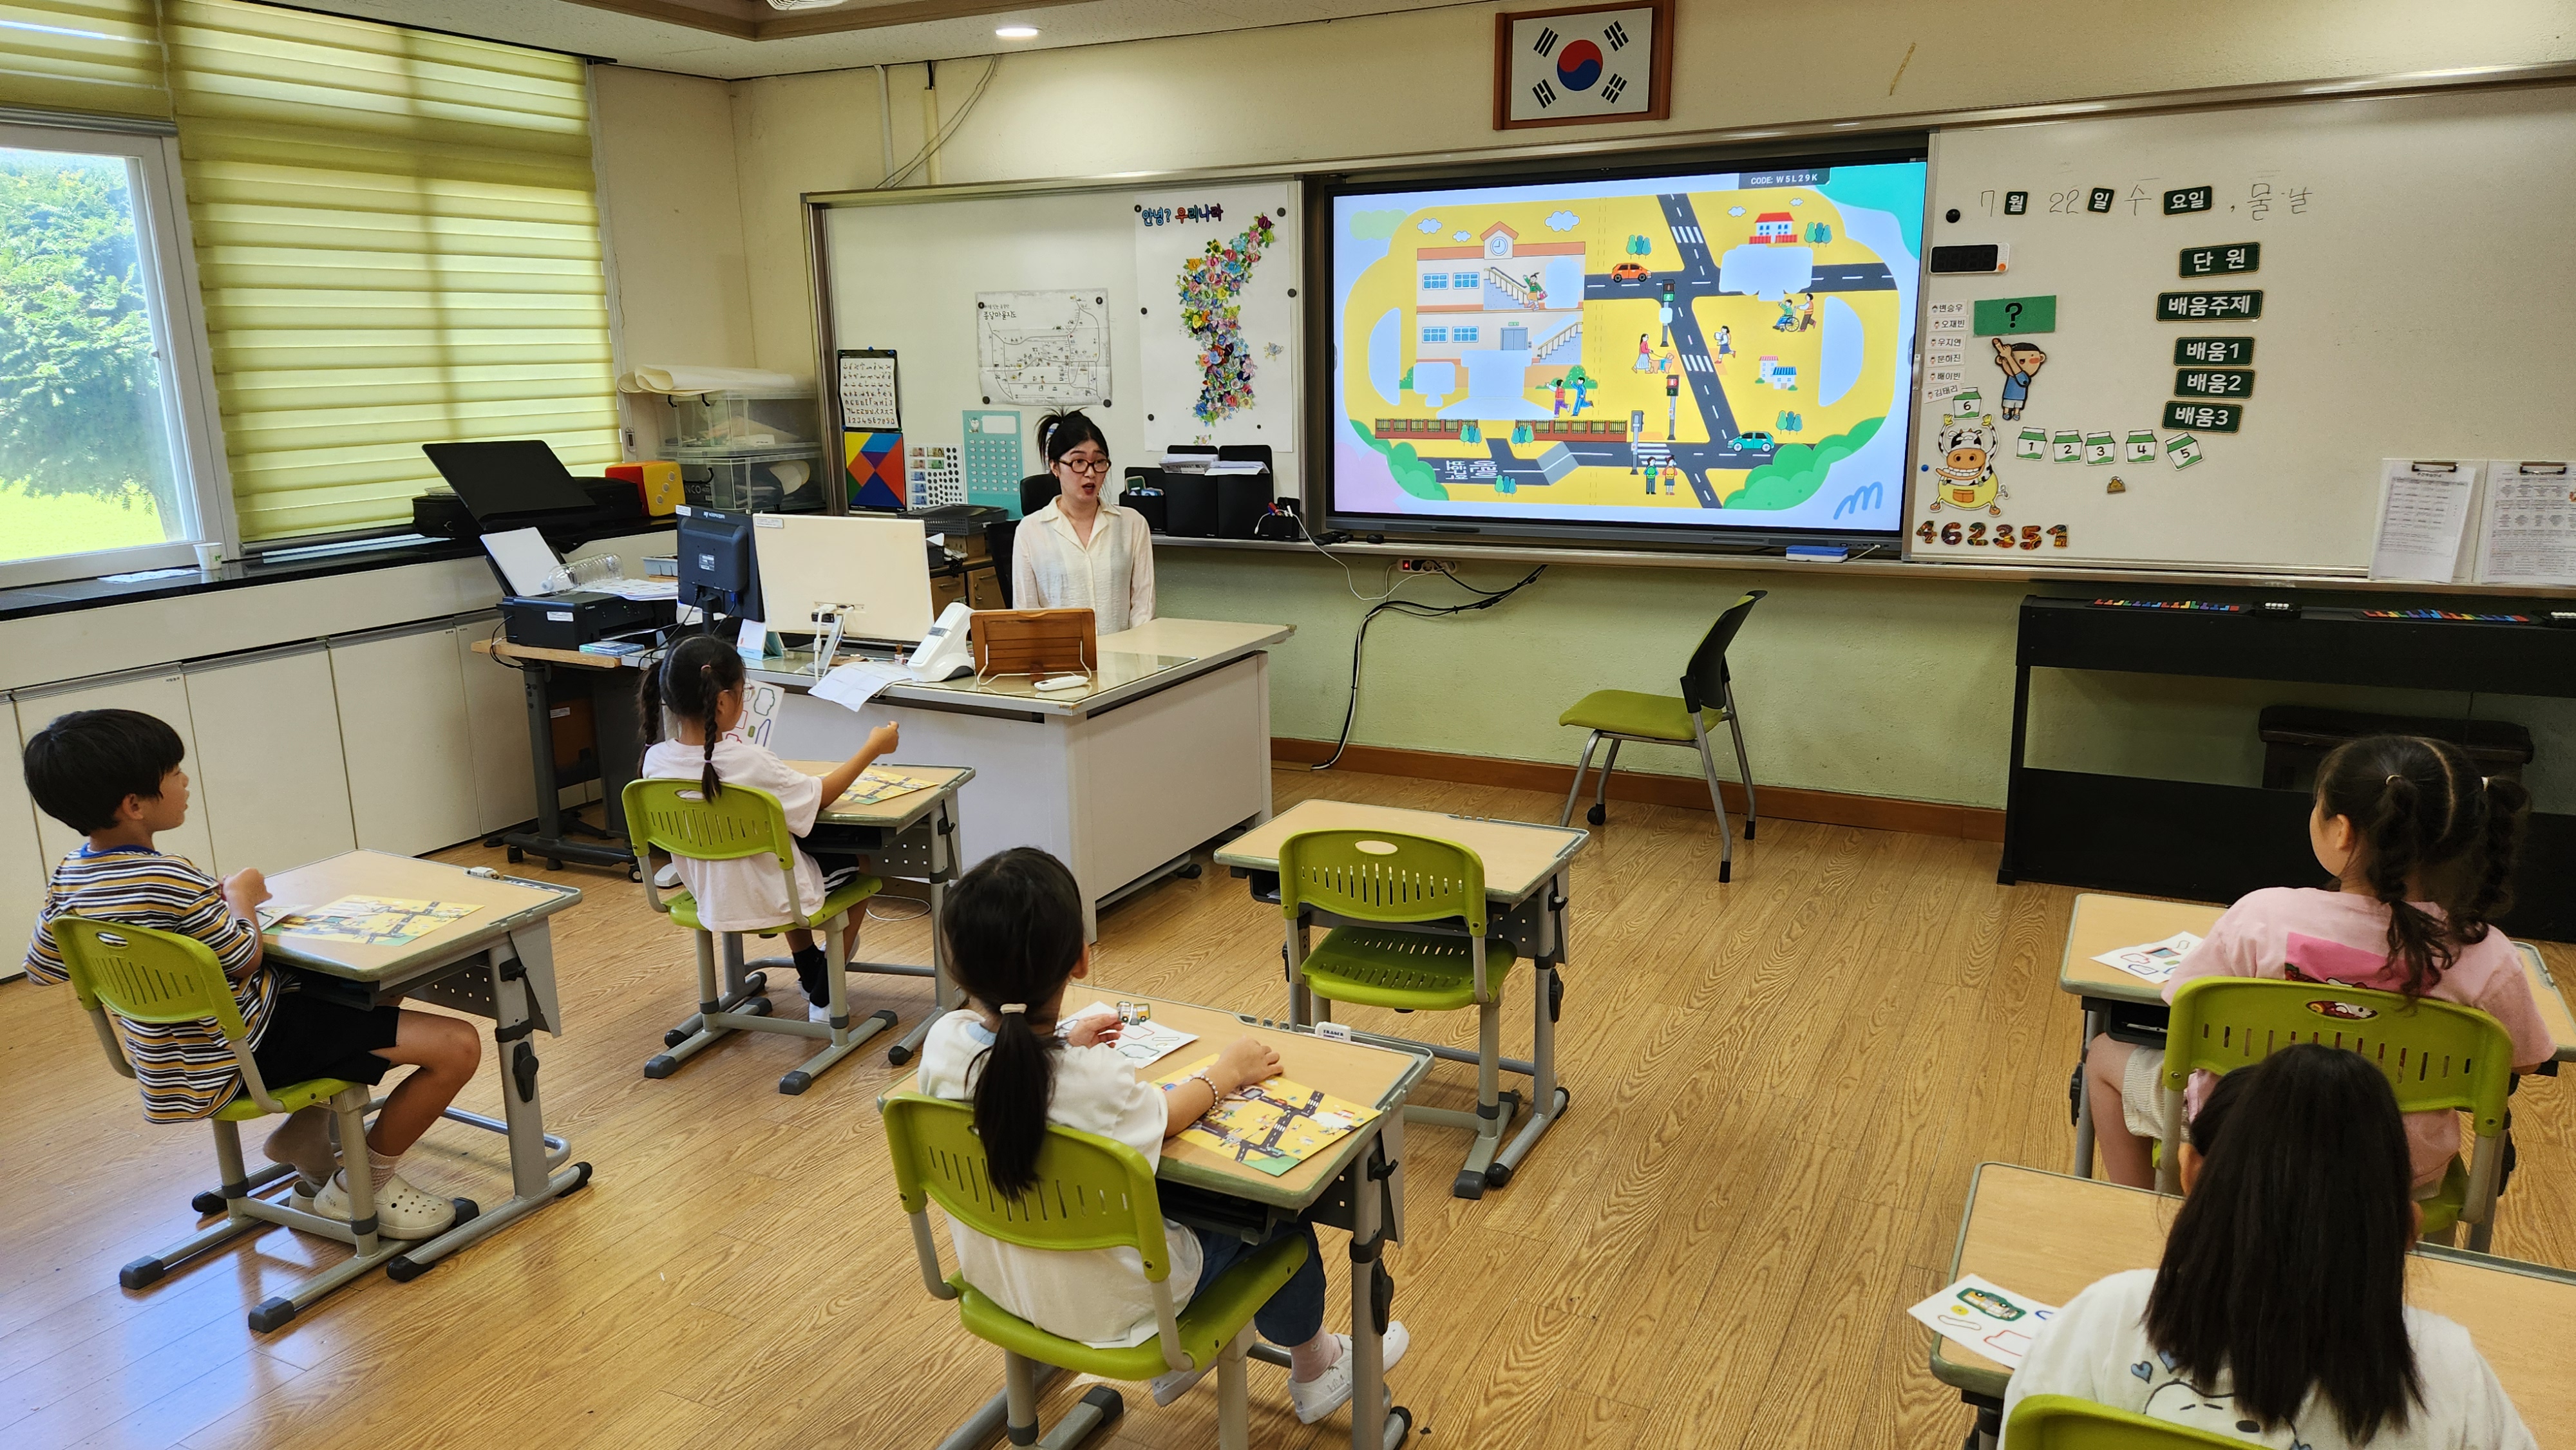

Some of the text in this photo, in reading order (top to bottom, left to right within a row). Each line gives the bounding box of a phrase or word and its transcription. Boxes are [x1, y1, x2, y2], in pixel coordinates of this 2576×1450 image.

[1750, 176, 1773, 185] CODE:
[1981, 190, 1995, 217] 7
[2009, 194, 2024, 212] 월
[2049, 189, 2079, 214] 22
[2094, 192, 2110, 210] 일
[2124, 184, 2152, 216] 수
[2170, 190, 2204, 209] 요일
[1142, 202, 1224, 227] 안녕? 우리나라
[1939, 303, 1963, 313] 변승우
[2168, 294, 2251, 316] 배움주제
[1941, 319, 1965, 328] 오재빈
[1938, 338, 1962, 347] 우지연
[2186, 341, 2239, 362] 배움1
[1937, 353, 1961, 364] 문하진
[1937, 372, 1961, 381] 배이빈
[2187, 373, 2242, 394] 배움2
[1934, 384, 1958, 397] 김태리
[1962, 400, 1972, 412] 6
[2175, 406, 2229, 428] 배움3
[2029, 441, 2190, 459] 1 2 3 4 5
